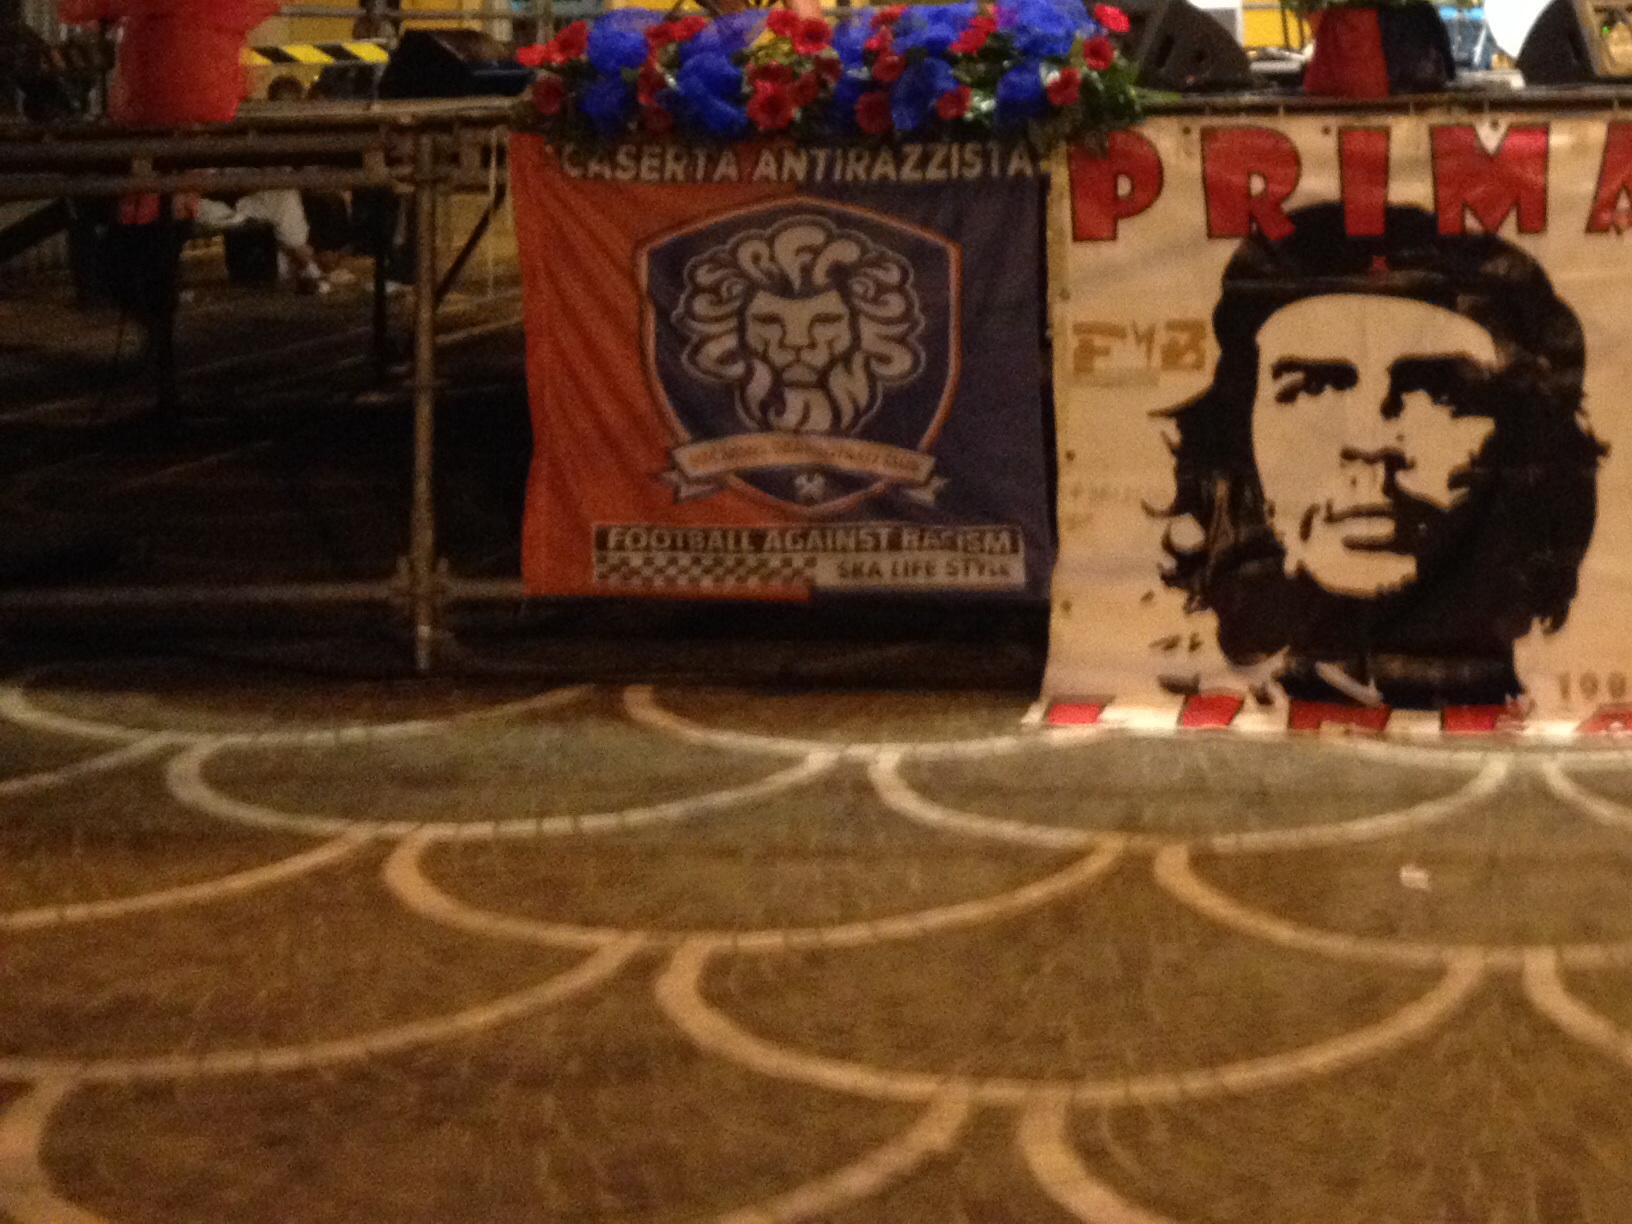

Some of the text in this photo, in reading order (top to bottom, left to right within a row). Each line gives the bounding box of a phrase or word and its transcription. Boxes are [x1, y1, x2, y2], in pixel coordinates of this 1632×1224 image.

[561, 140, 1034, 181] CASERTA ANTIRAZZISTA
[608, 527, 1012, 553] FOOTBALL AGAINST RACISM
